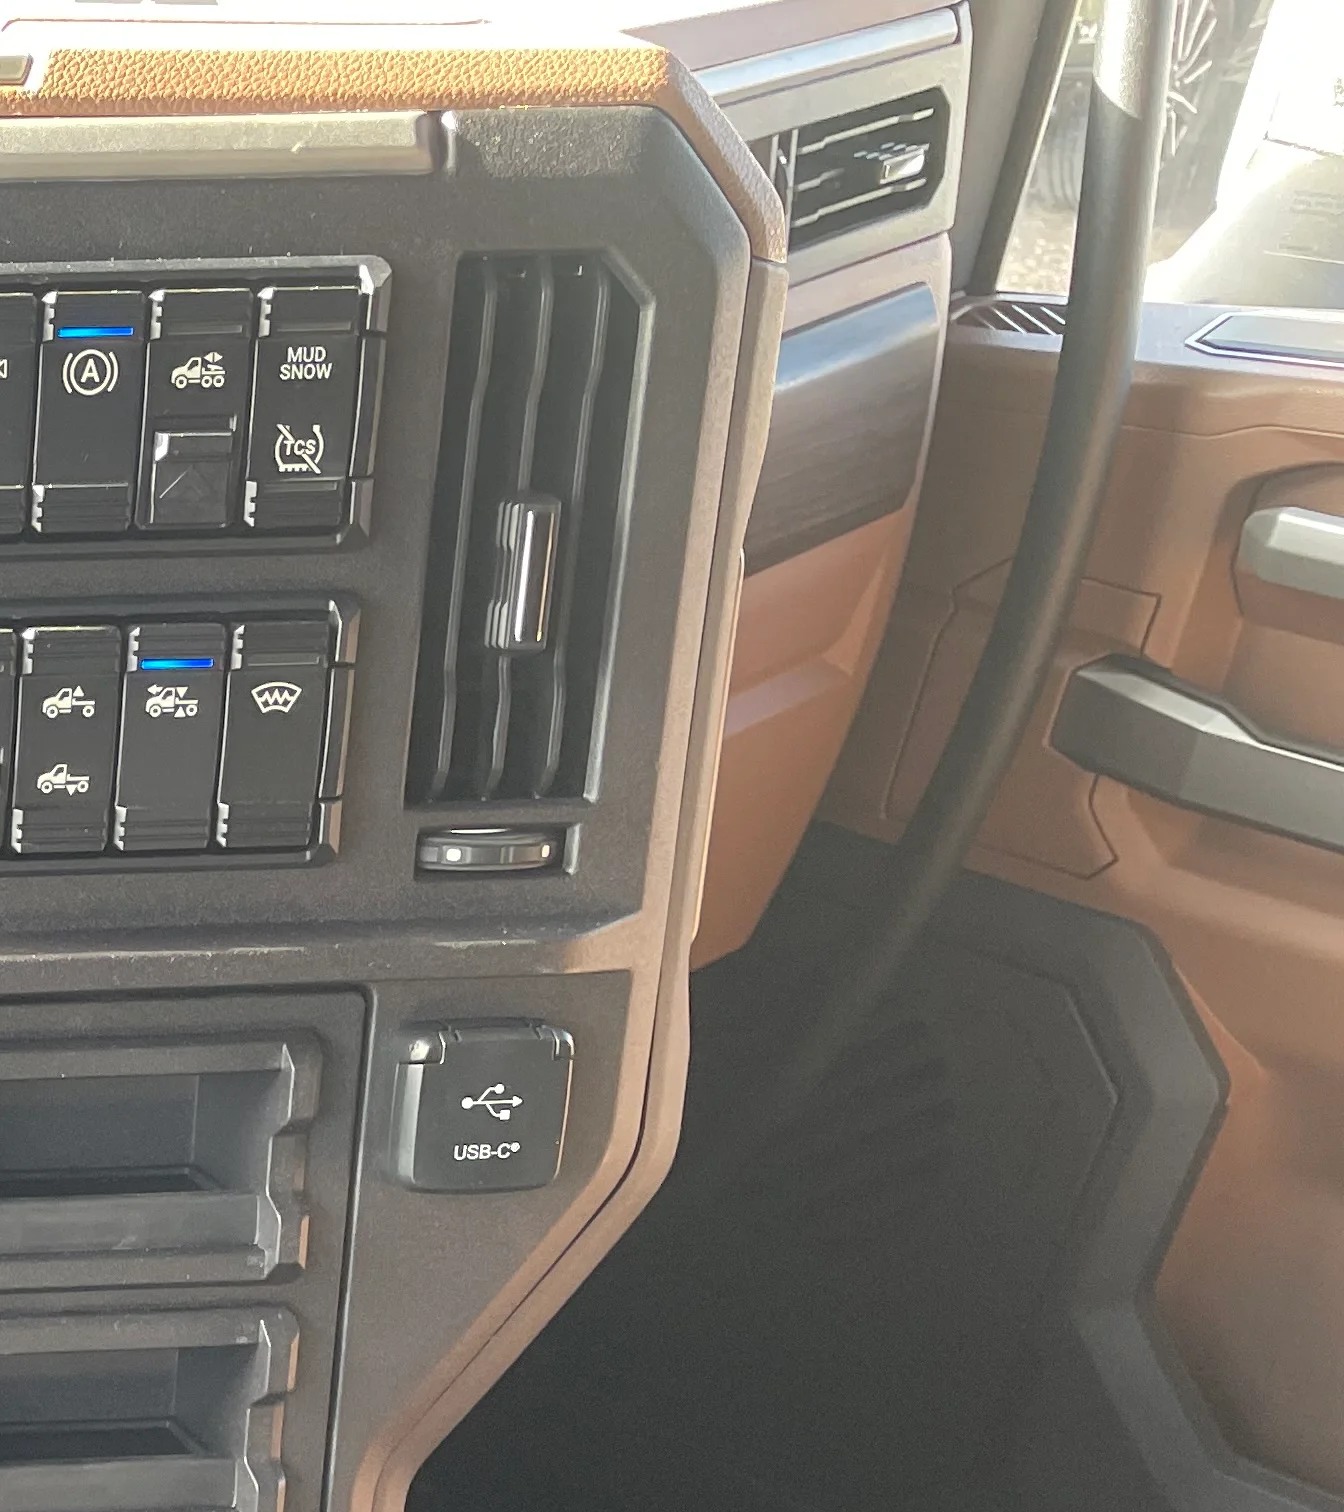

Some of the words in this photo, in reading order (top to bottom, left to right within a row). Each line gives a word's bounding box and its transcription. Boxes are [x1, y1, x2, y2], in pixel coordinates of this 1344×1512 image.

[287, 346, 327, 363] MUD
[279, 363, 333, 381] SNOW
[283, 439, 317, 457] TCS
